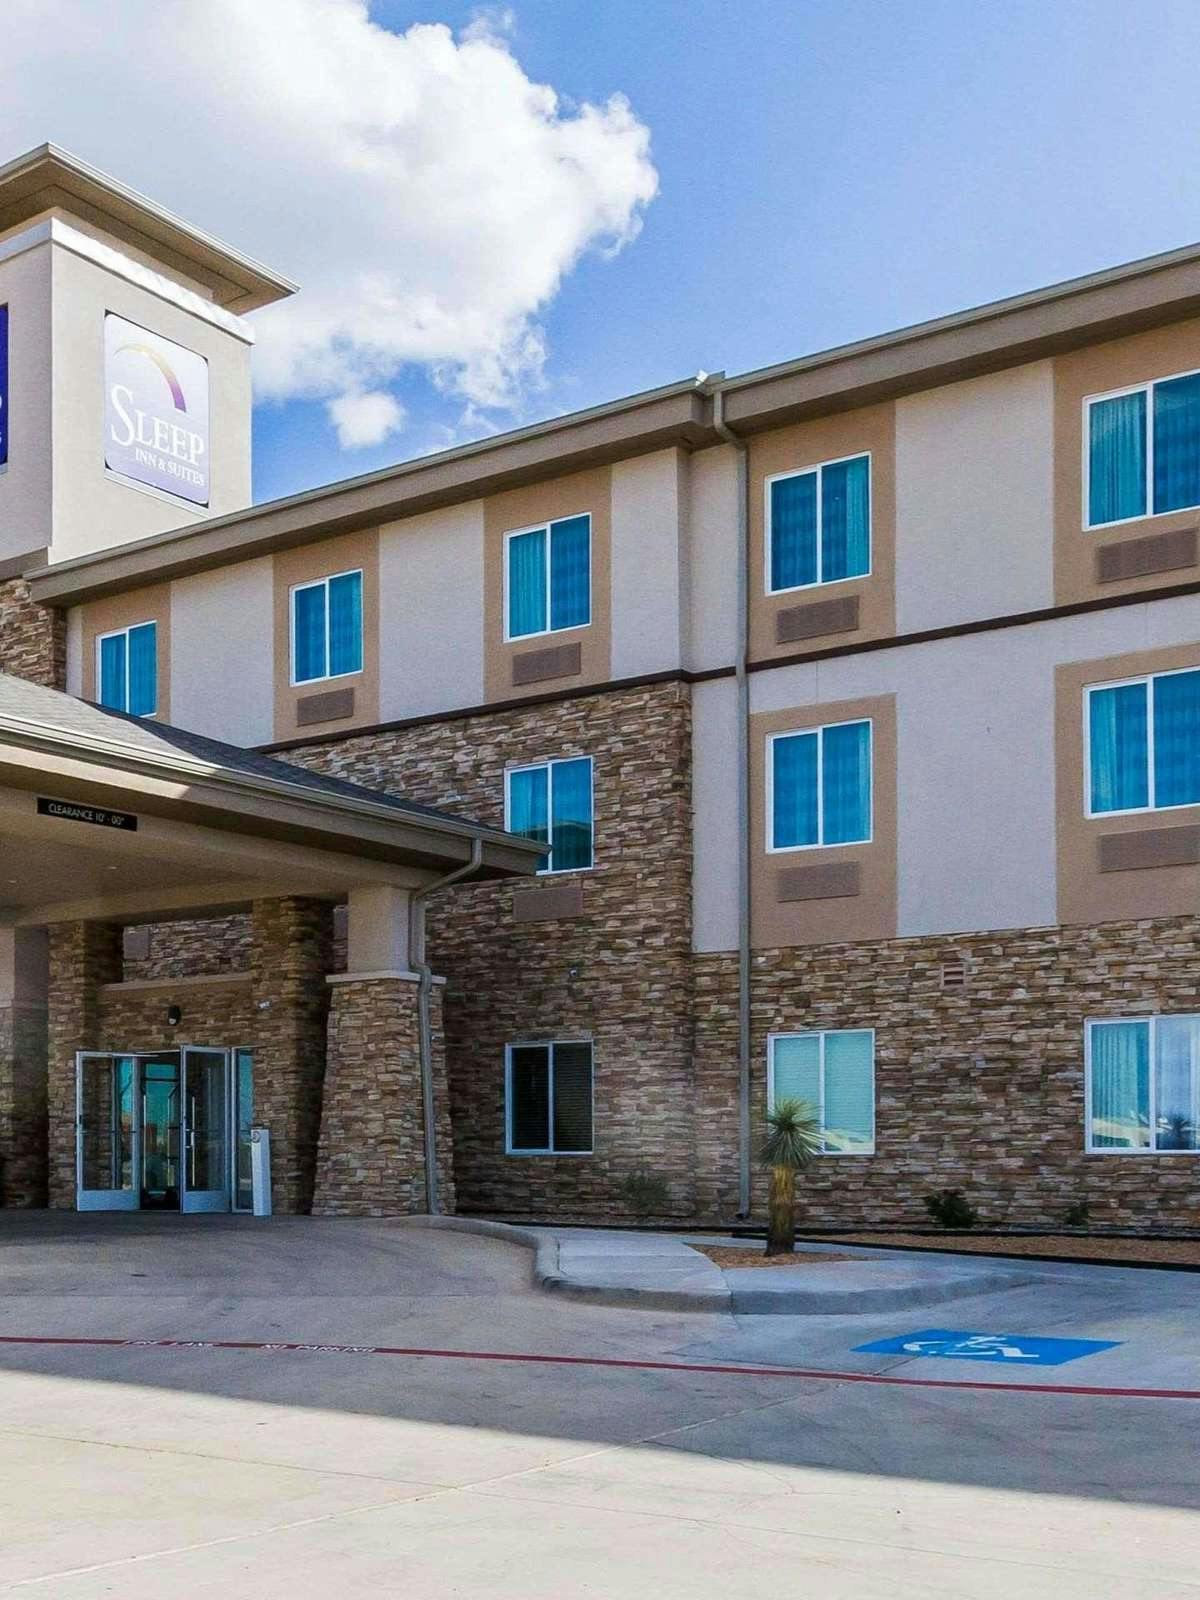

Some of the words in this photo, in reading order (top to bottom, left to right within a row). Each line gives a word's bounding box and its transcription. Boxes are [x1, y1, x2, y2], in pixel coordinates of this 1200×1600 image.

[111, 385, 204, 466] SLEEP
[135, 447, 158, 468] INN
[167, 461, 205, 487] SUITES
[48, 803, 93, 820] CLEARANCE
